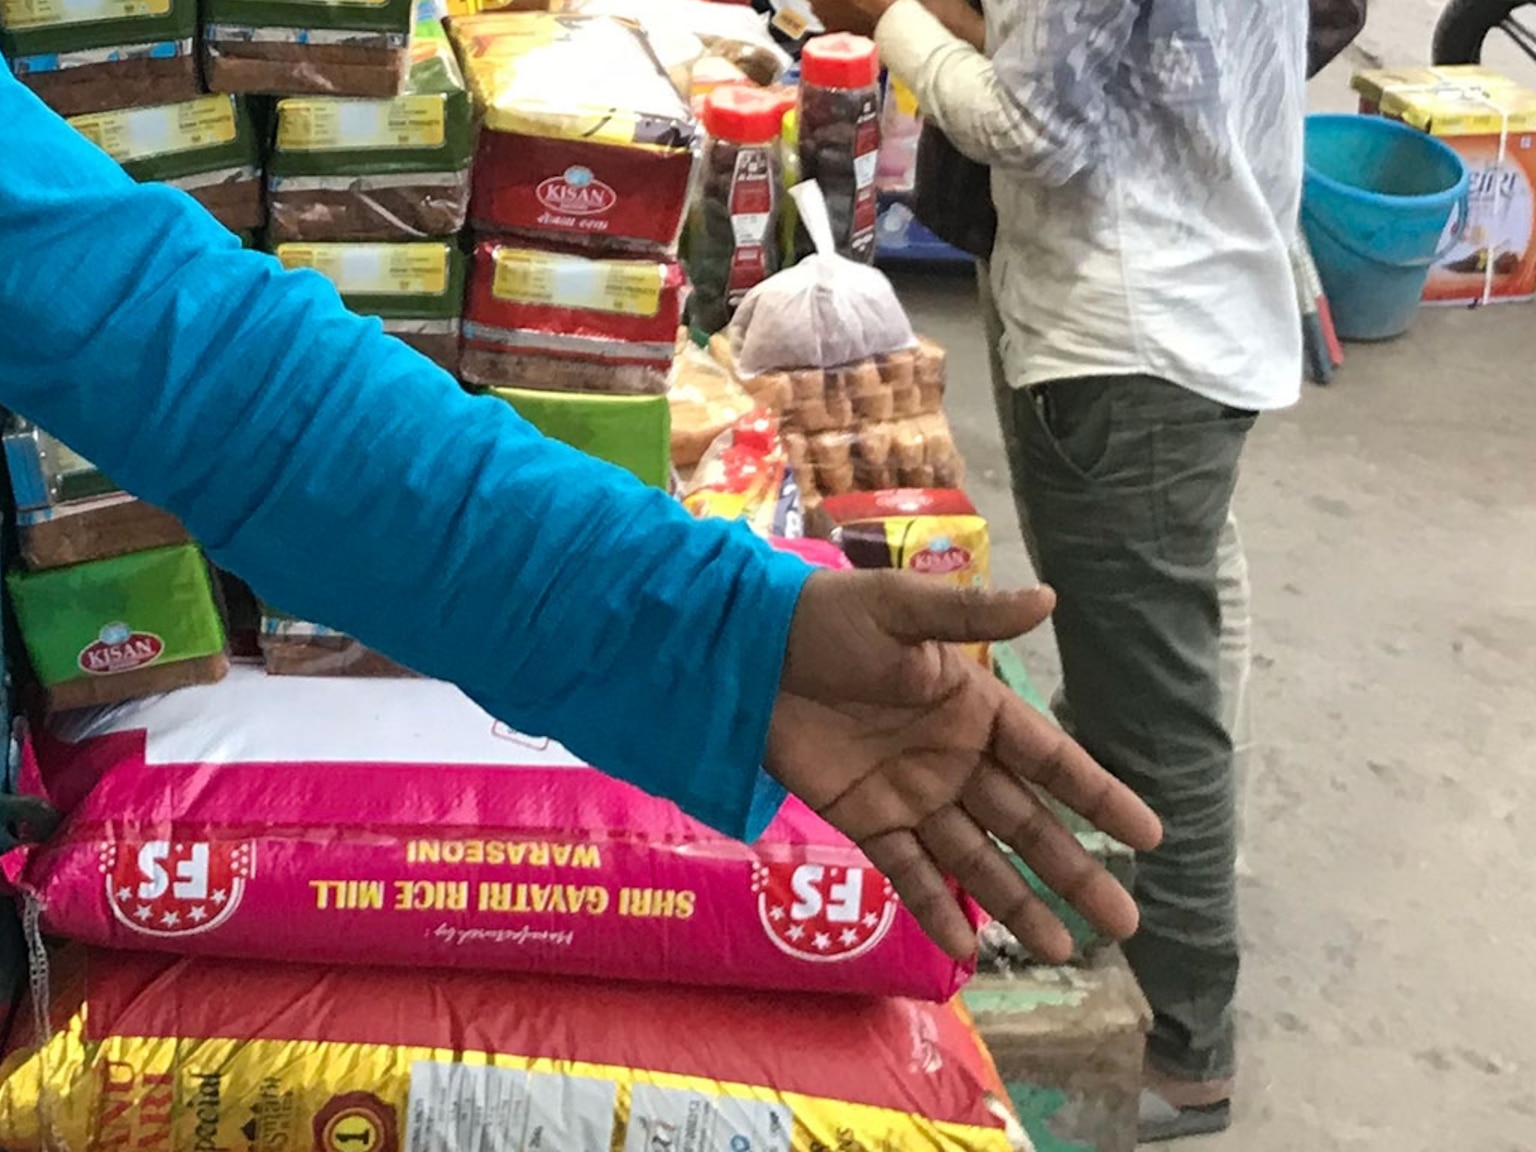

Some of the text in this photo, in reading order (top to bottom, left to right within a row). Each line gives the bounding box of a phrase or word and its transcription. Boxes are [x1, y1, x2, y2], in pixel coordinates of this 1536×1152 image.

[546, 183, 605, 203] KISAN
[88, 638, 153, 668] KISAN
[406, 838, 602, 869] WARASEONI
[309, 878, 697, 920] SHRI GAYATRI RICE MILL
